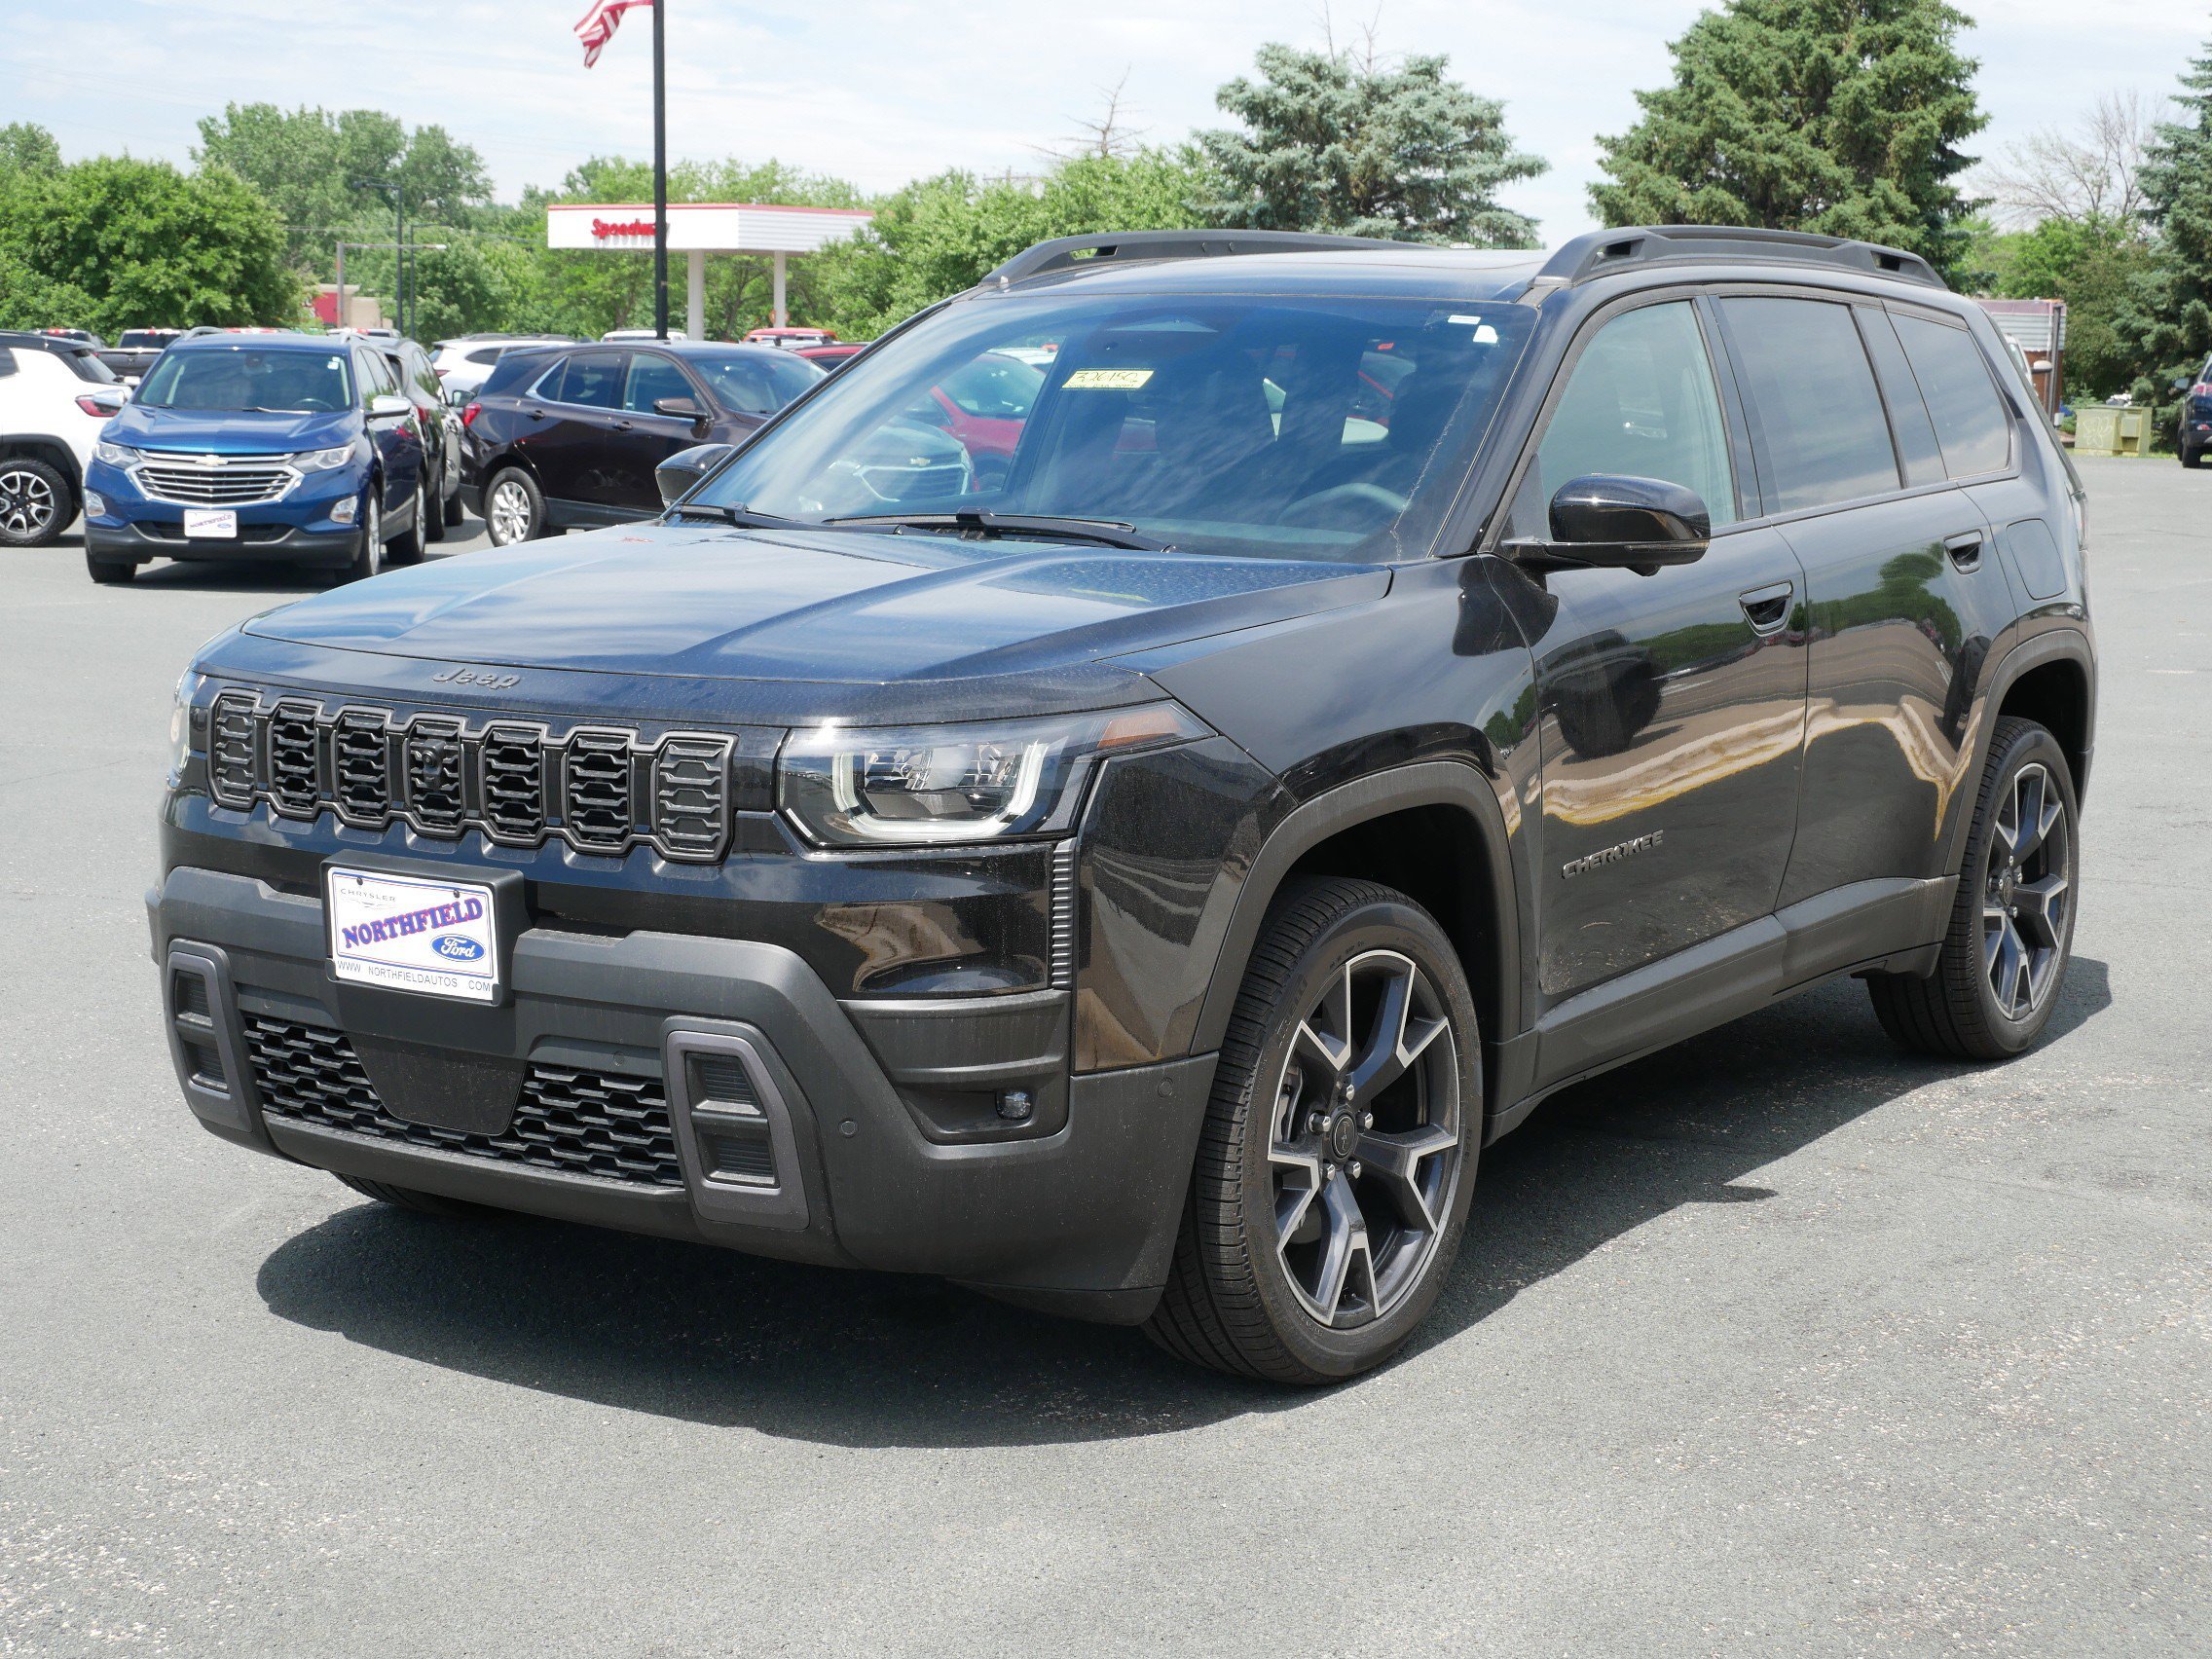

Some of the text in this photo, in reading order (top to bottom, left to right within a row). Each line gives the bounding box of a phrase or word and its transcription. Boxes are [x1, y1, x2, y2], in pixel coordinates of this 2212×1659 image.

[591, 218, 670, 240] Speedw
[432, 668, 521, 690] Jeep
[1562, 830, 1664, 879] CHEROKEE
[341, 888, 396, 903] CHRYSLER
[342, 898, 484, 949] NORTHFIELD
[440, 937, 476, 958] Ford
